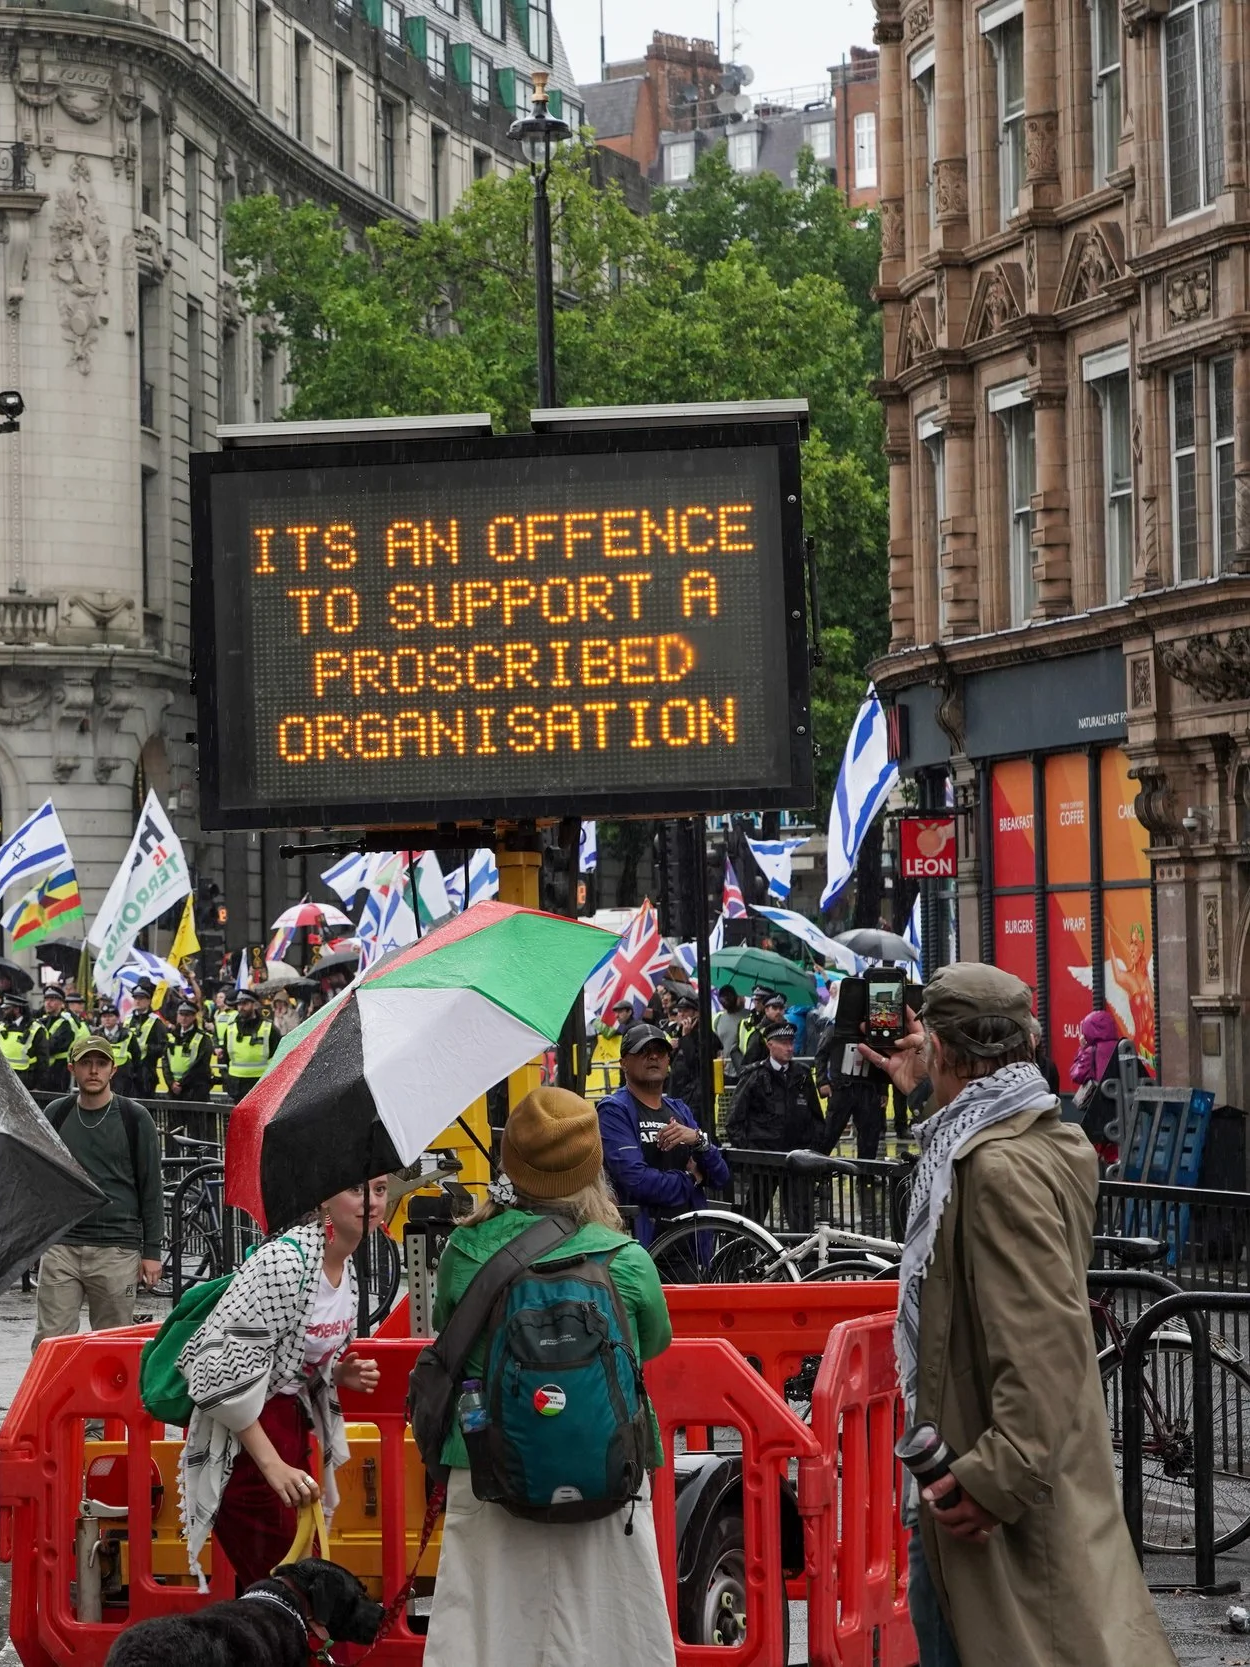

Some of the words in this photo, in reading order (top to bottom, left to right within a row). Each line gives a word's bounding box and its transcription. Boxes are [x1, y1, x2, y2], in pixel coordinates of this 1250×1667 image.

[255, 525, 357, 574] ITS
[387, 519, 459, 567] AN
[488, 505, 754, 563] OFFENCE
[289, 588, 360, 634] TO
[389, 572, 652, 630] SUPPORT
[682, 570, 718, 618] A
[314, 634, 695, 697] PROSCRIBED
[278, 697, 736, 762] ORGANISATION
[1078, 716, 1107, 729] NATURALLY
[1108, 713, 1120, 725] FAST
[999, 814, 1035, 832] BREAKFAST
[1060, 809, 1085, 826] COFFEE
[906, 858, 953, 875] LEON
[1004, 919, 1034, 934] BURGERS
[1062, 917, 1086, 932] WRAPS
[1064, 1023, 1084, 1038] SALA
